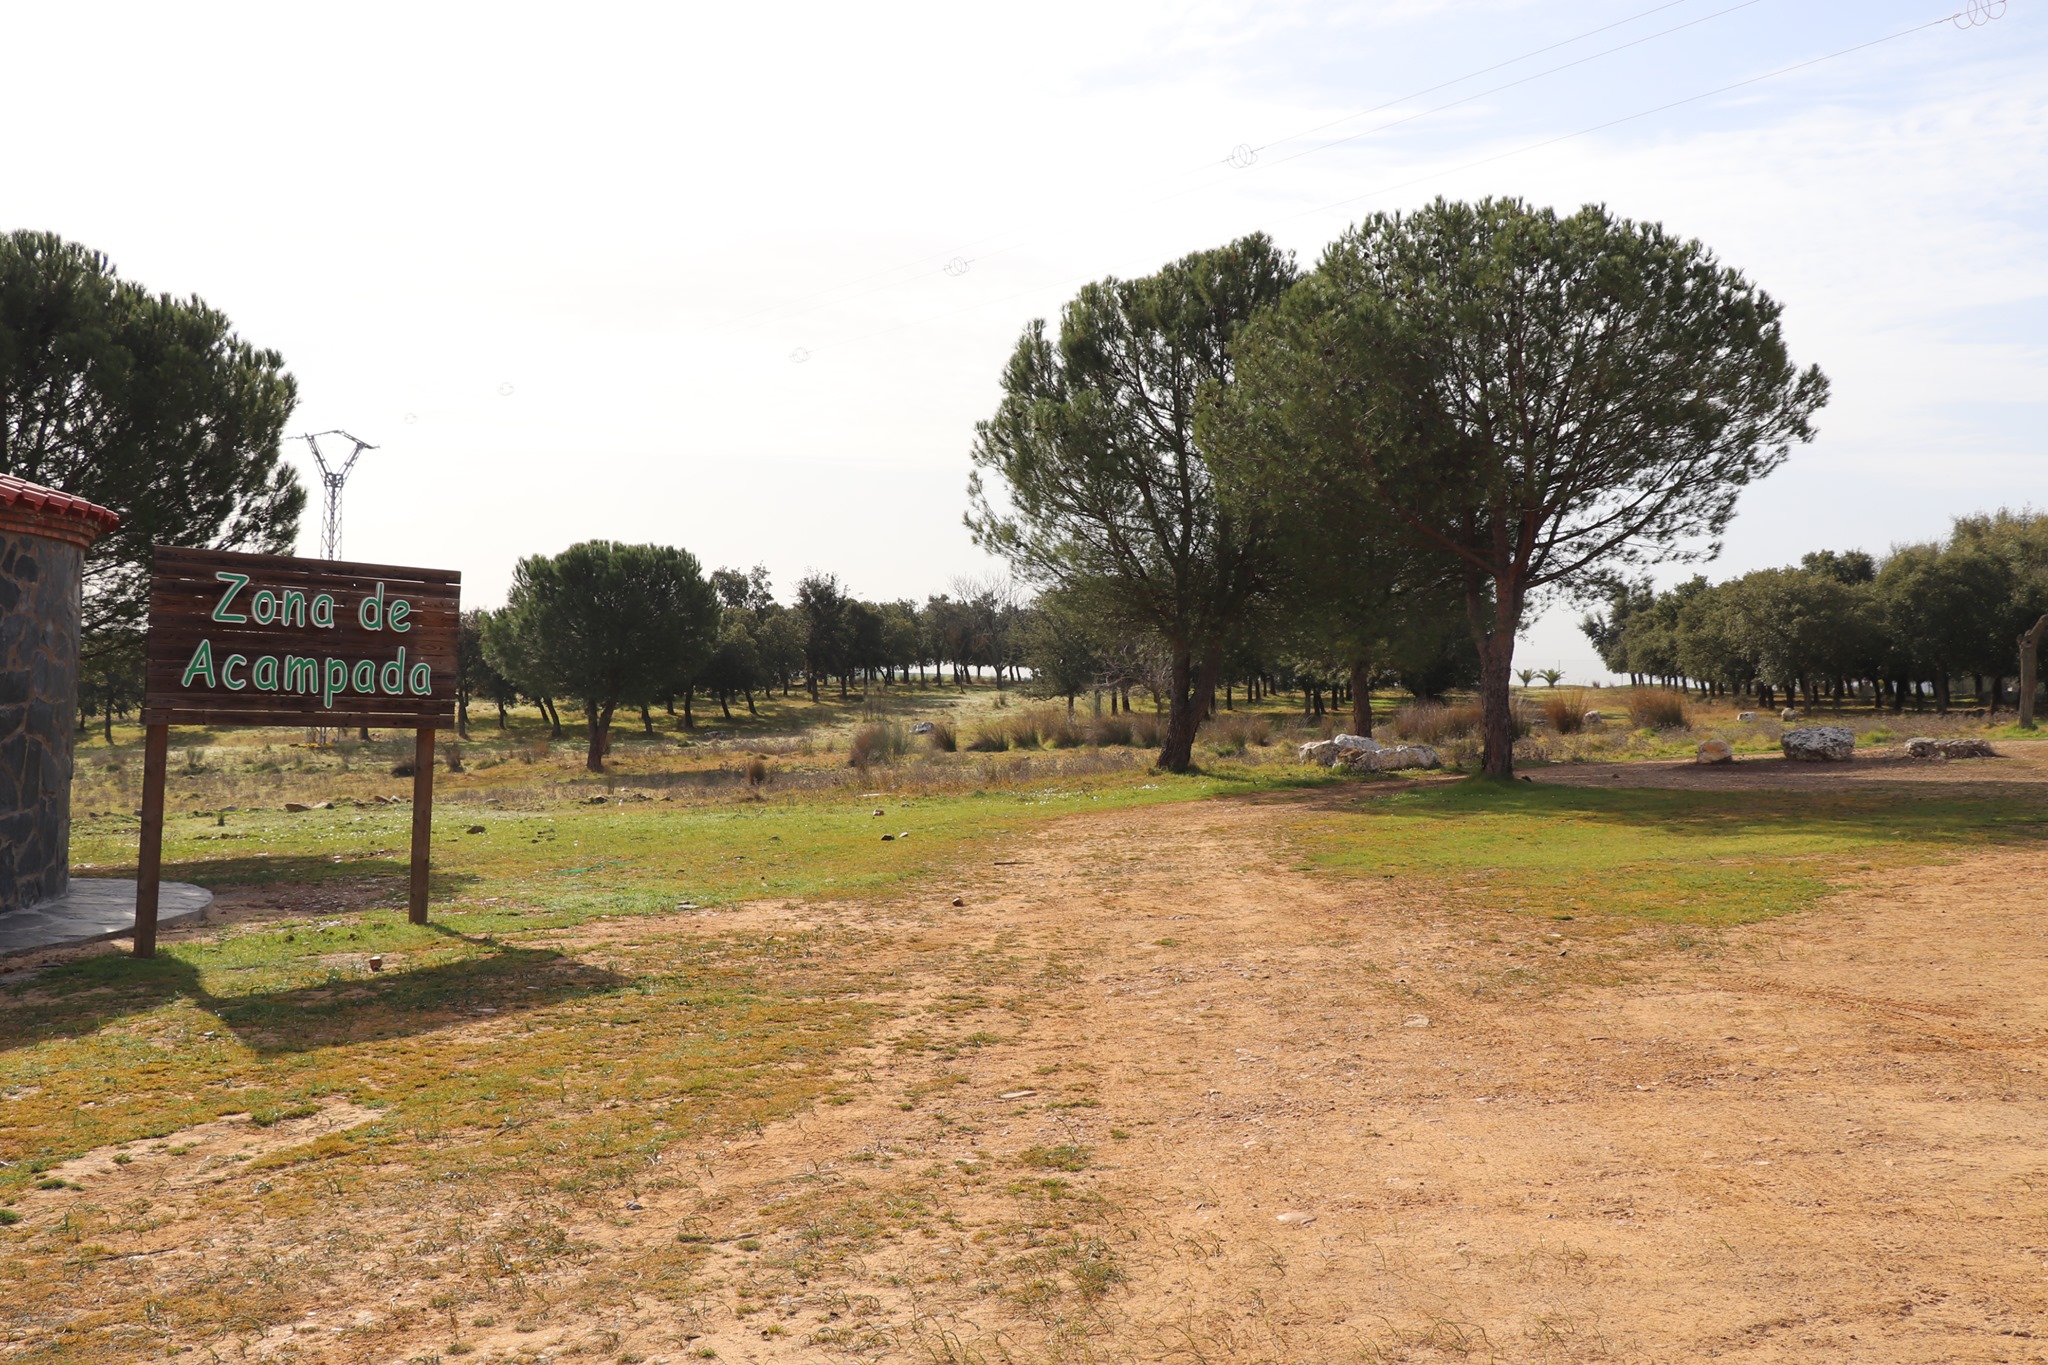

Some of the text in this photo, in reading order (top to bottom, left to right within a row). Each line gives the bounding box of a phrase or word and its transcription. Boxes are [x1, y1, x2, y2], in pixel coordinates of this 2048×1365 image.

[212, 571, 411, 632] Zona de
[181, 638, 432, 709] Acampada
